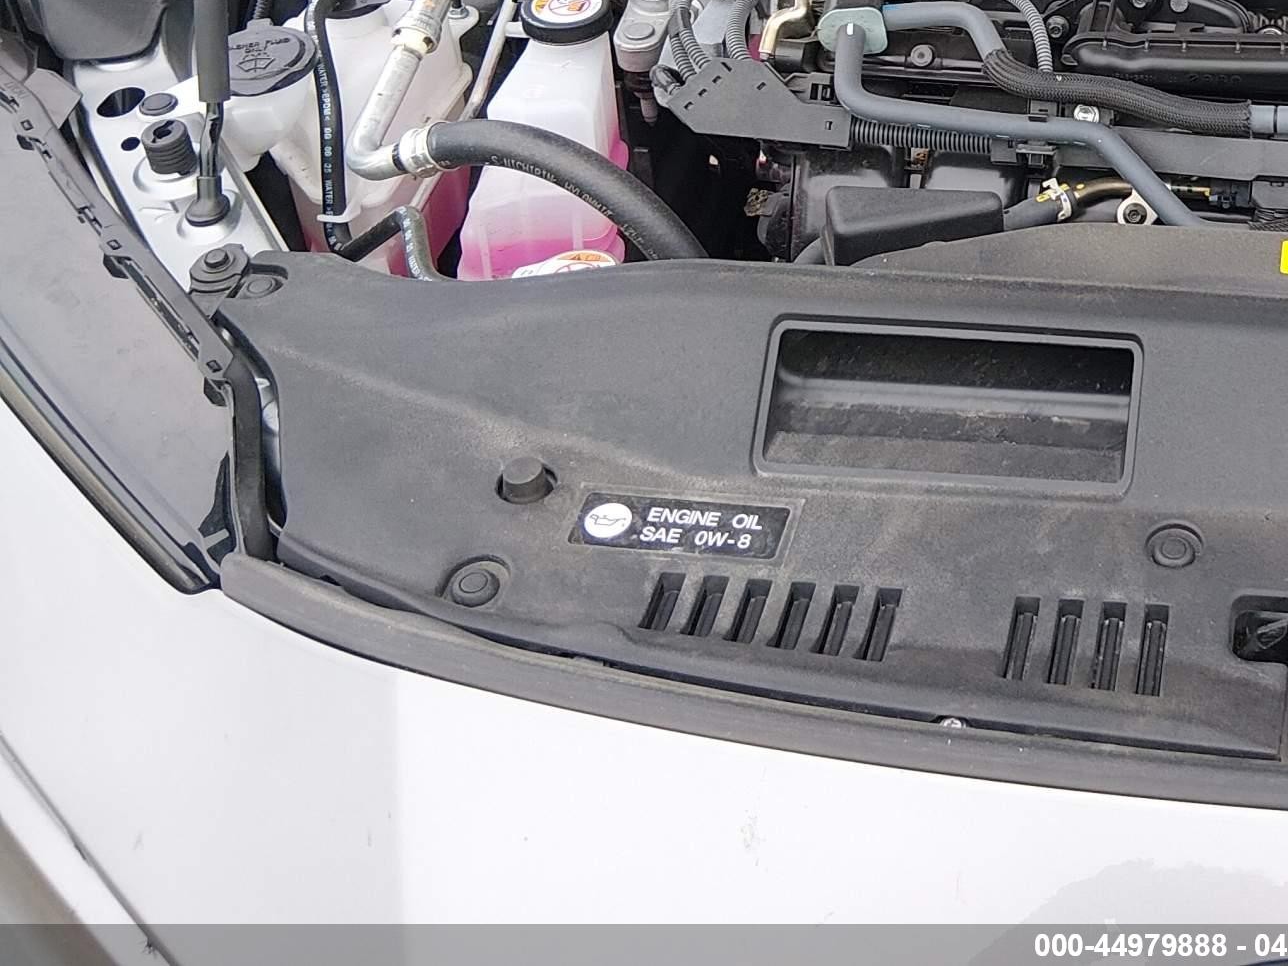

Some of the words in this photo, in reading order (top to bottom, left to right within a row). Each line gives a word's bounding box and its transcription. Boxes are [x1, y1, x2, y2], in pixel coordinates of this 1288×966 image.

[646, 507, 721, 527] ENGINE
[731, 513, 763, 530] OIL
[639, 525, 682, 544] SAE
